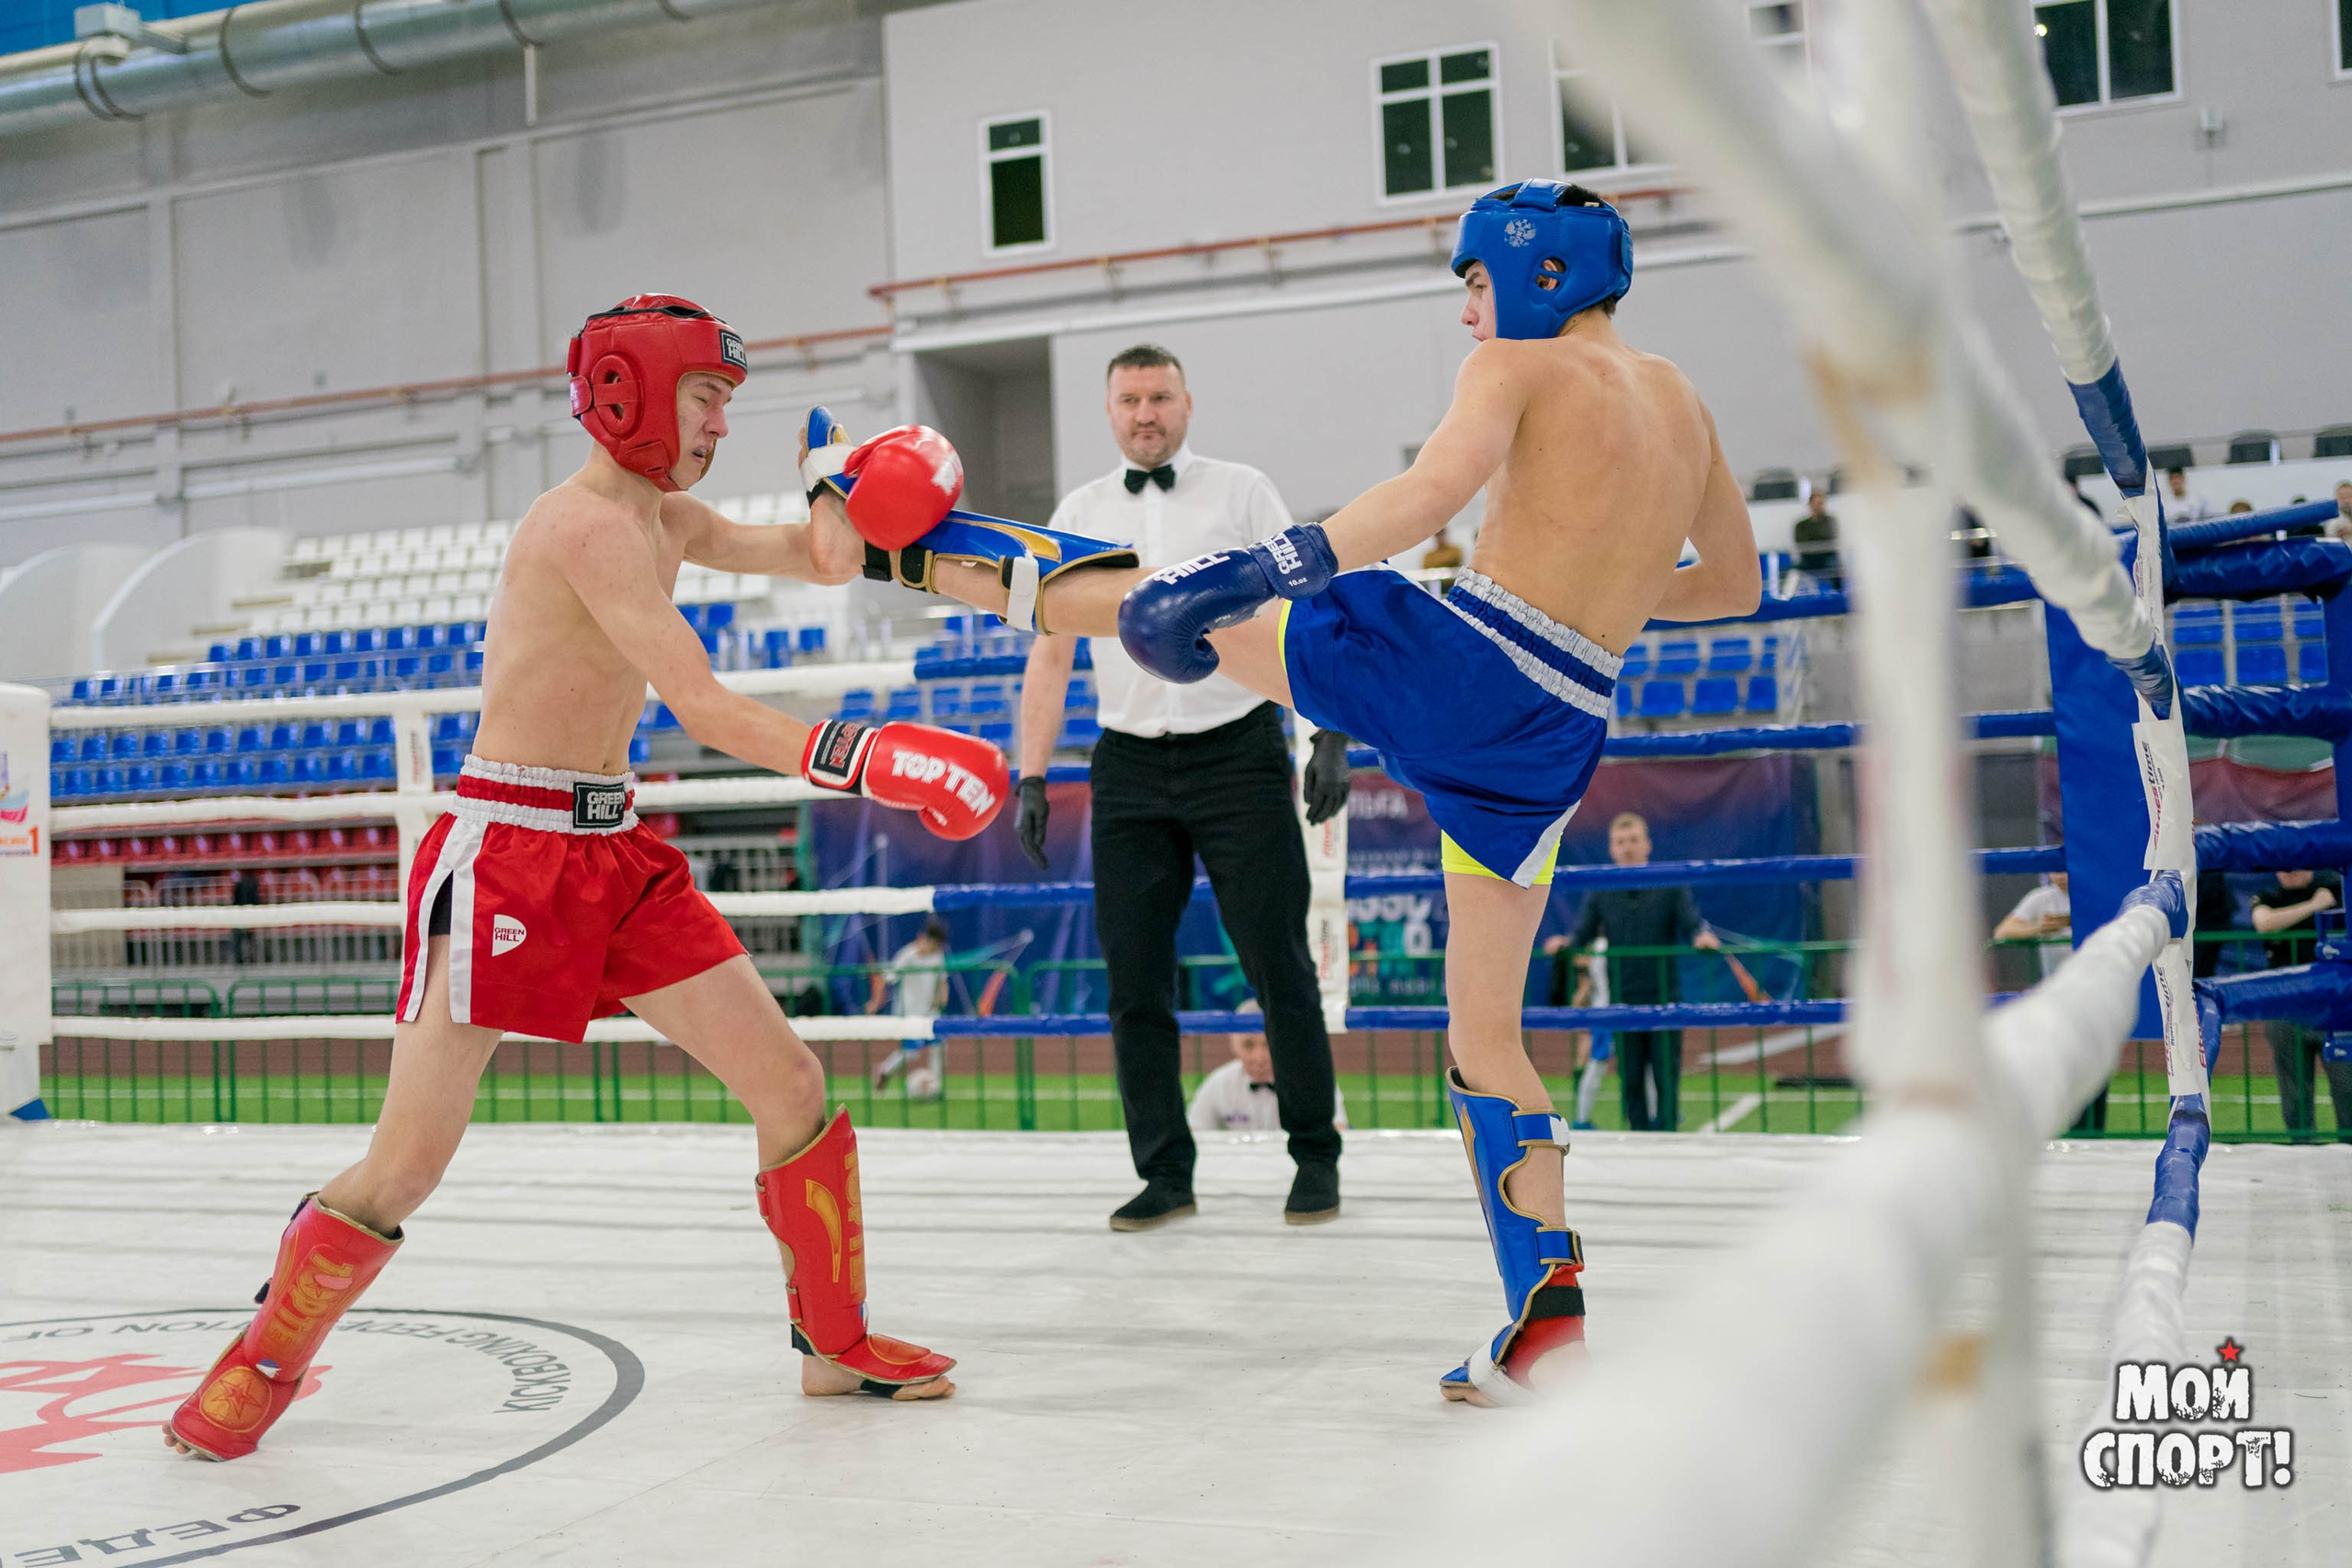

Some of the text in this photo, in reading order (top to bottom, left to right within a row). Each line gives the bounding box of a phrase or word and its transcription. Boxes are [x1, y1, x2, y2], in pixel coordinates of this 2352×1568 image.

[891, 750, 946, 784] TOP
[944, 762, 997, 819] TEN
[587, 791, 626, 805] GREEN
[587, 804, 619, 820] HILL
[494, 927, 526, 935] GREEN
[494, 933, 520, 942] HILL
[2, 1326, 95, 1343] OF
[444, 1331, 571, 1414] KICKBOXING
[0, 1504, 301, 1568] ФЕДЕ
